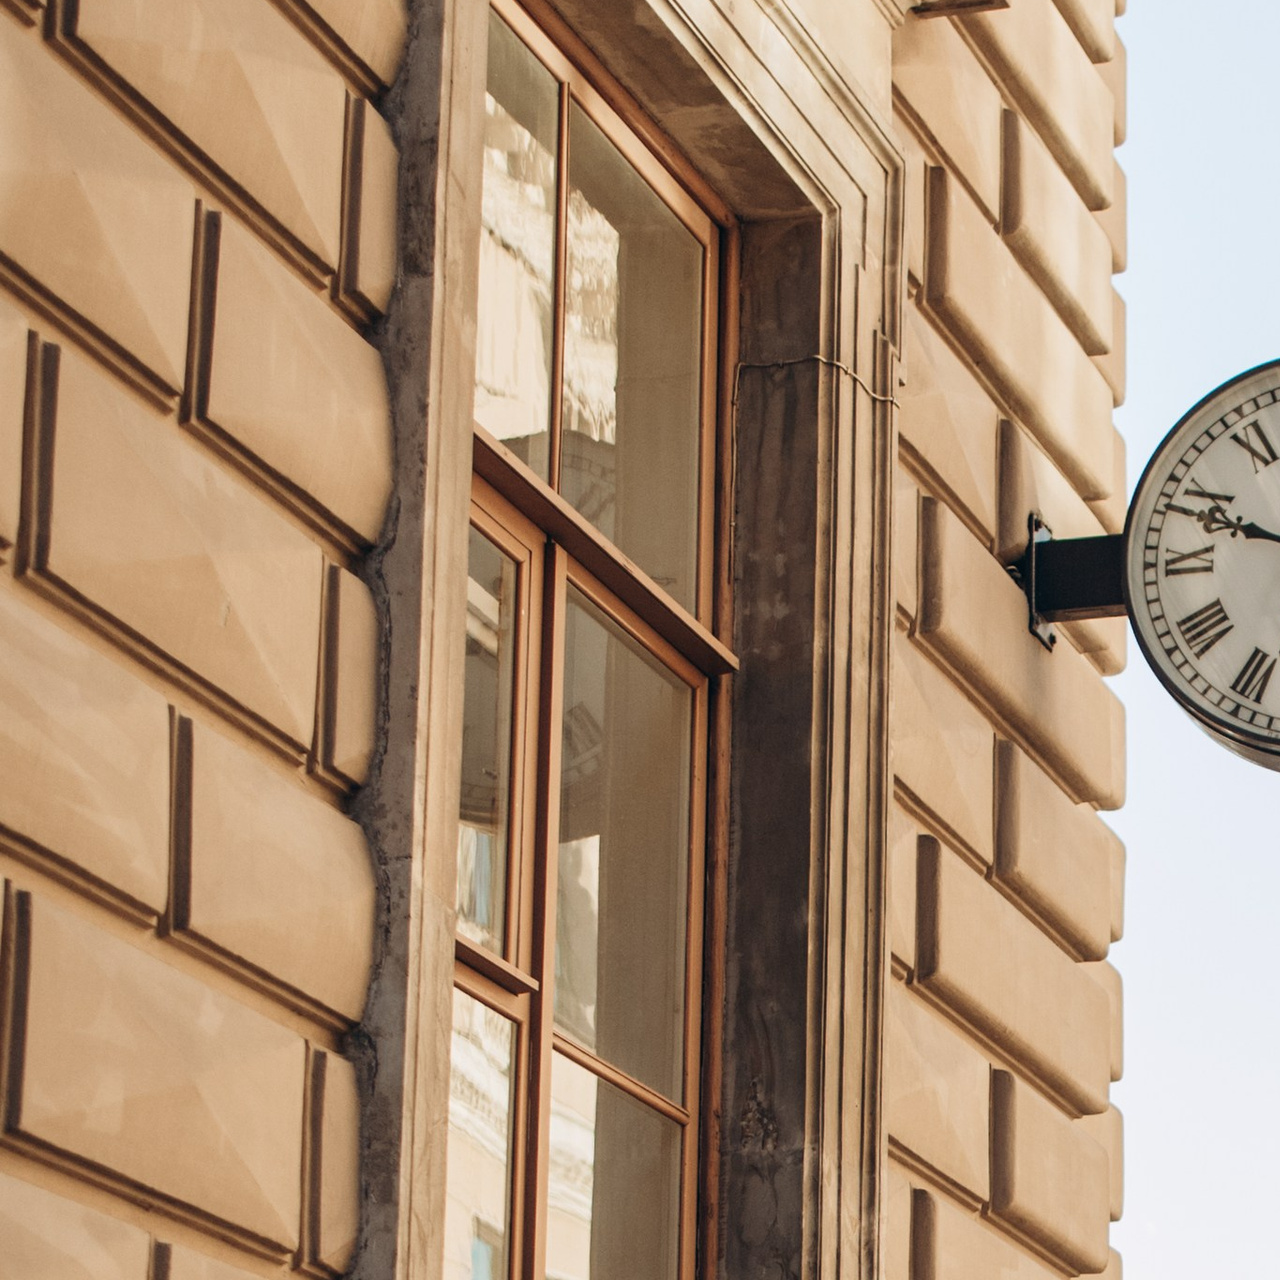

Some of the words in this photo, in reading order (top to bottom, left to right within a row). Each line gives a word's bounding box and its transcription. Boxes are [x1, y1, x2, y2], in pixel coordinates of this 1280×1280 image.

[1230, 419, 1280, 474] XI
[1183, 477, 1236, 514] X
[1165, 544, 1215, 577] IX
[1176, 597, 1234, 660] VIII
[1229, 646, 1277, 704] VII
